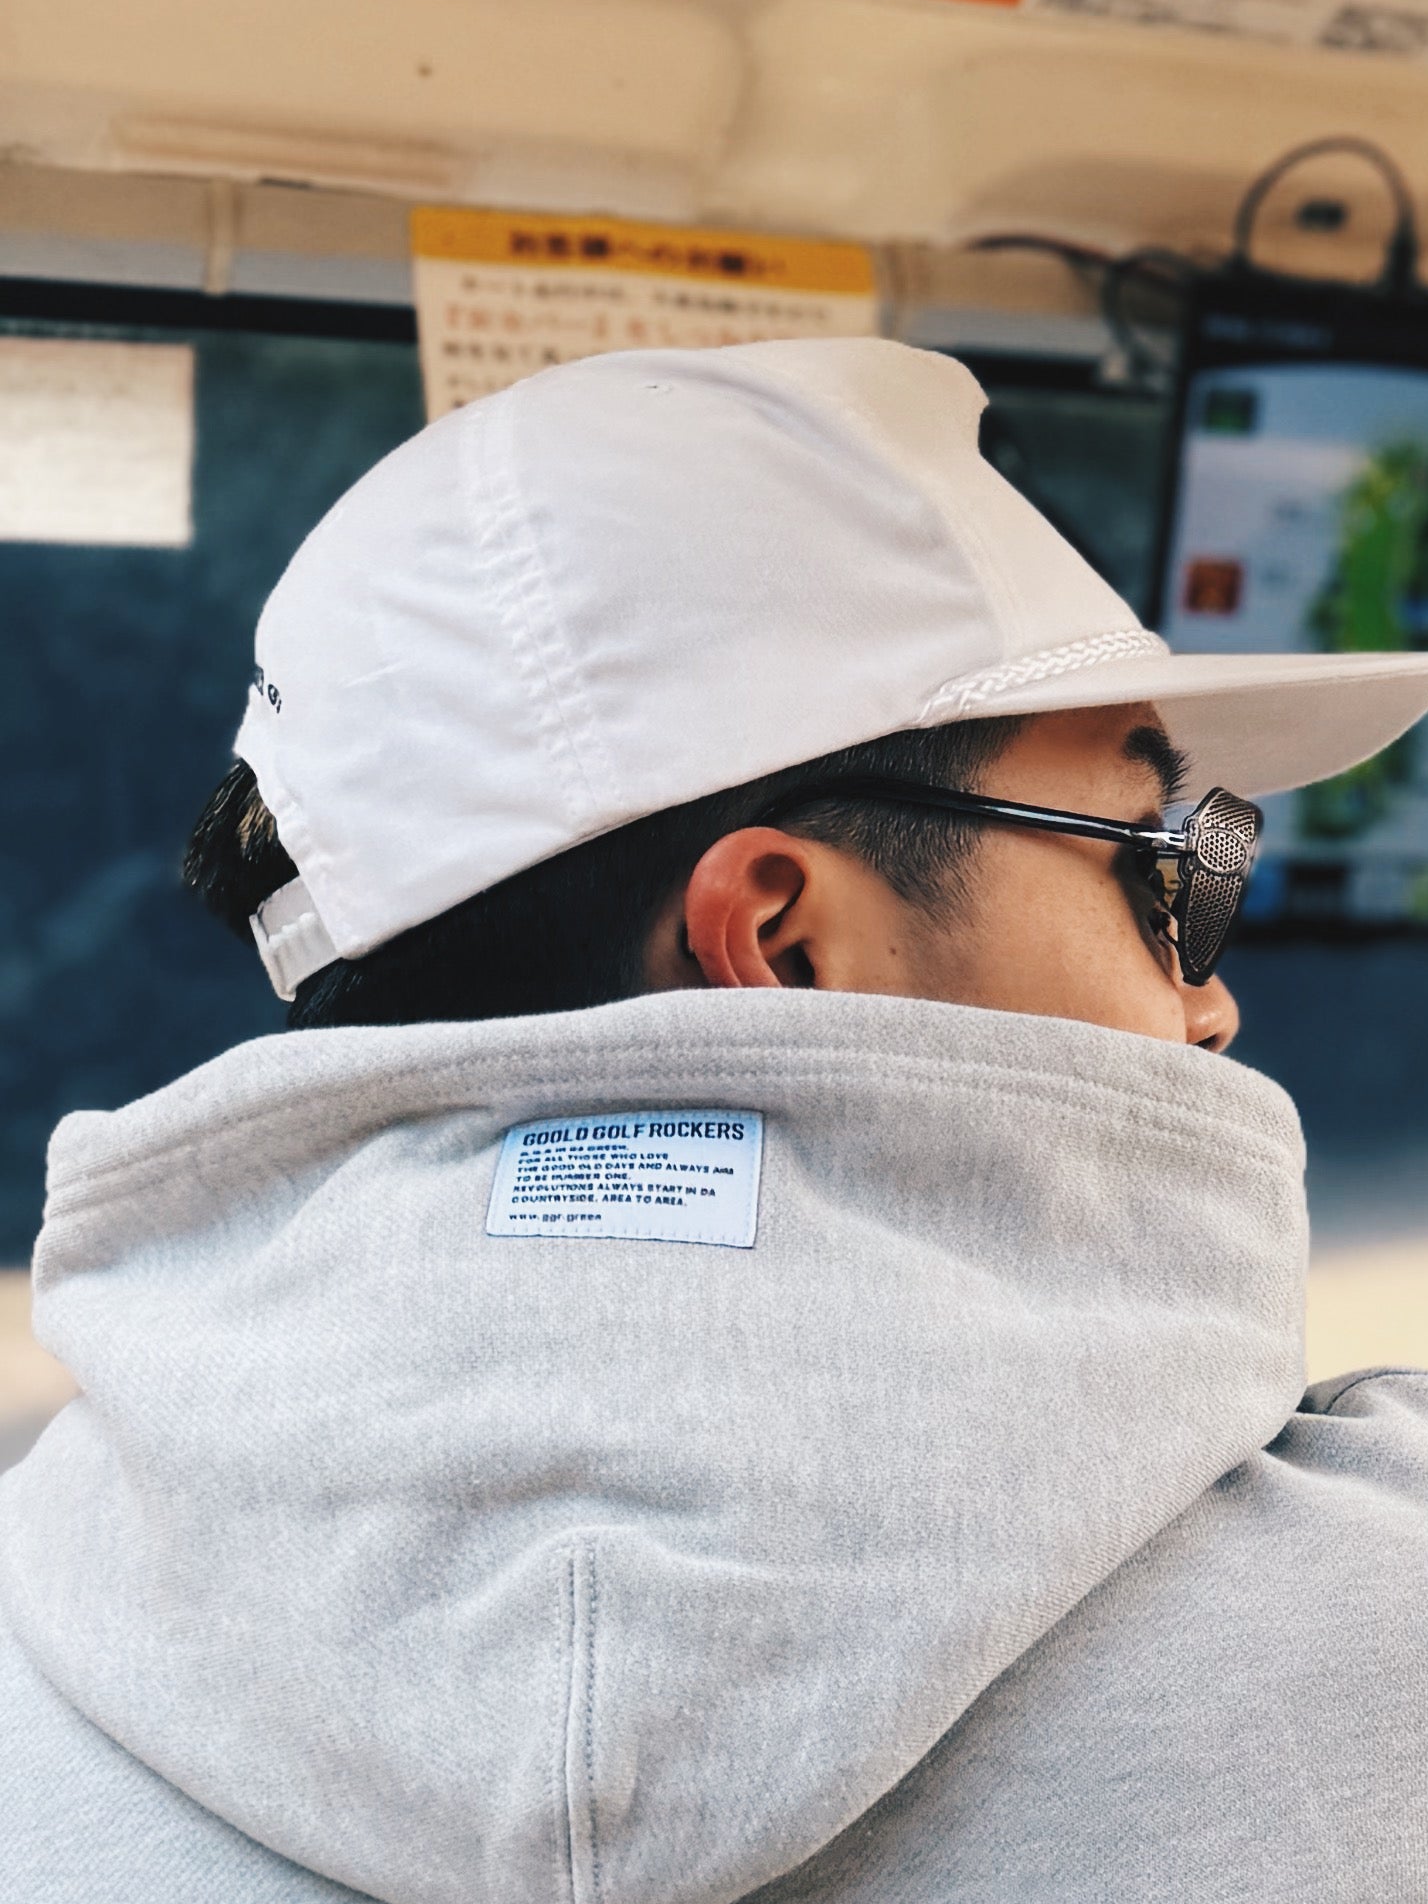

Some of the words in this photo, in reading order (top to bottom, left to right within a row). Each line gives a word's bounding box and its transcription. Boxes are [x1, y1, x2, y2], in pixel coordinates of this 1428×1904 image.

[523, 1127, 589, 1146] GOOLD
[592, 1124, 645, 1140] GOLF
[648, 1121, 745, 1141] ROCKERS
[568, 1153, 606, 1161] THOSE
[640, 1153, 669, 1161] LOVE
[541, 1163, 576, 1172] GOOD
[578, 1163, 602, 1171] OLD
[605, 1162, 635, 1170] DAYS
[638, 1162, 662, 1170] AND
[666, 1163, 709, 1173] ALWAYS
[513, 1183, 594, 1192] REVOLUTIONS
[597, 1183, 644, 1191] ALWAYS
[647, 1184, 683, 1193] START
[685, 1186, 697, 1195] IN
[700, 1188, 716, 1196] DA
[602, 1194, 632, 1202] AREA
[636, 1194, 652, 1203] TO
